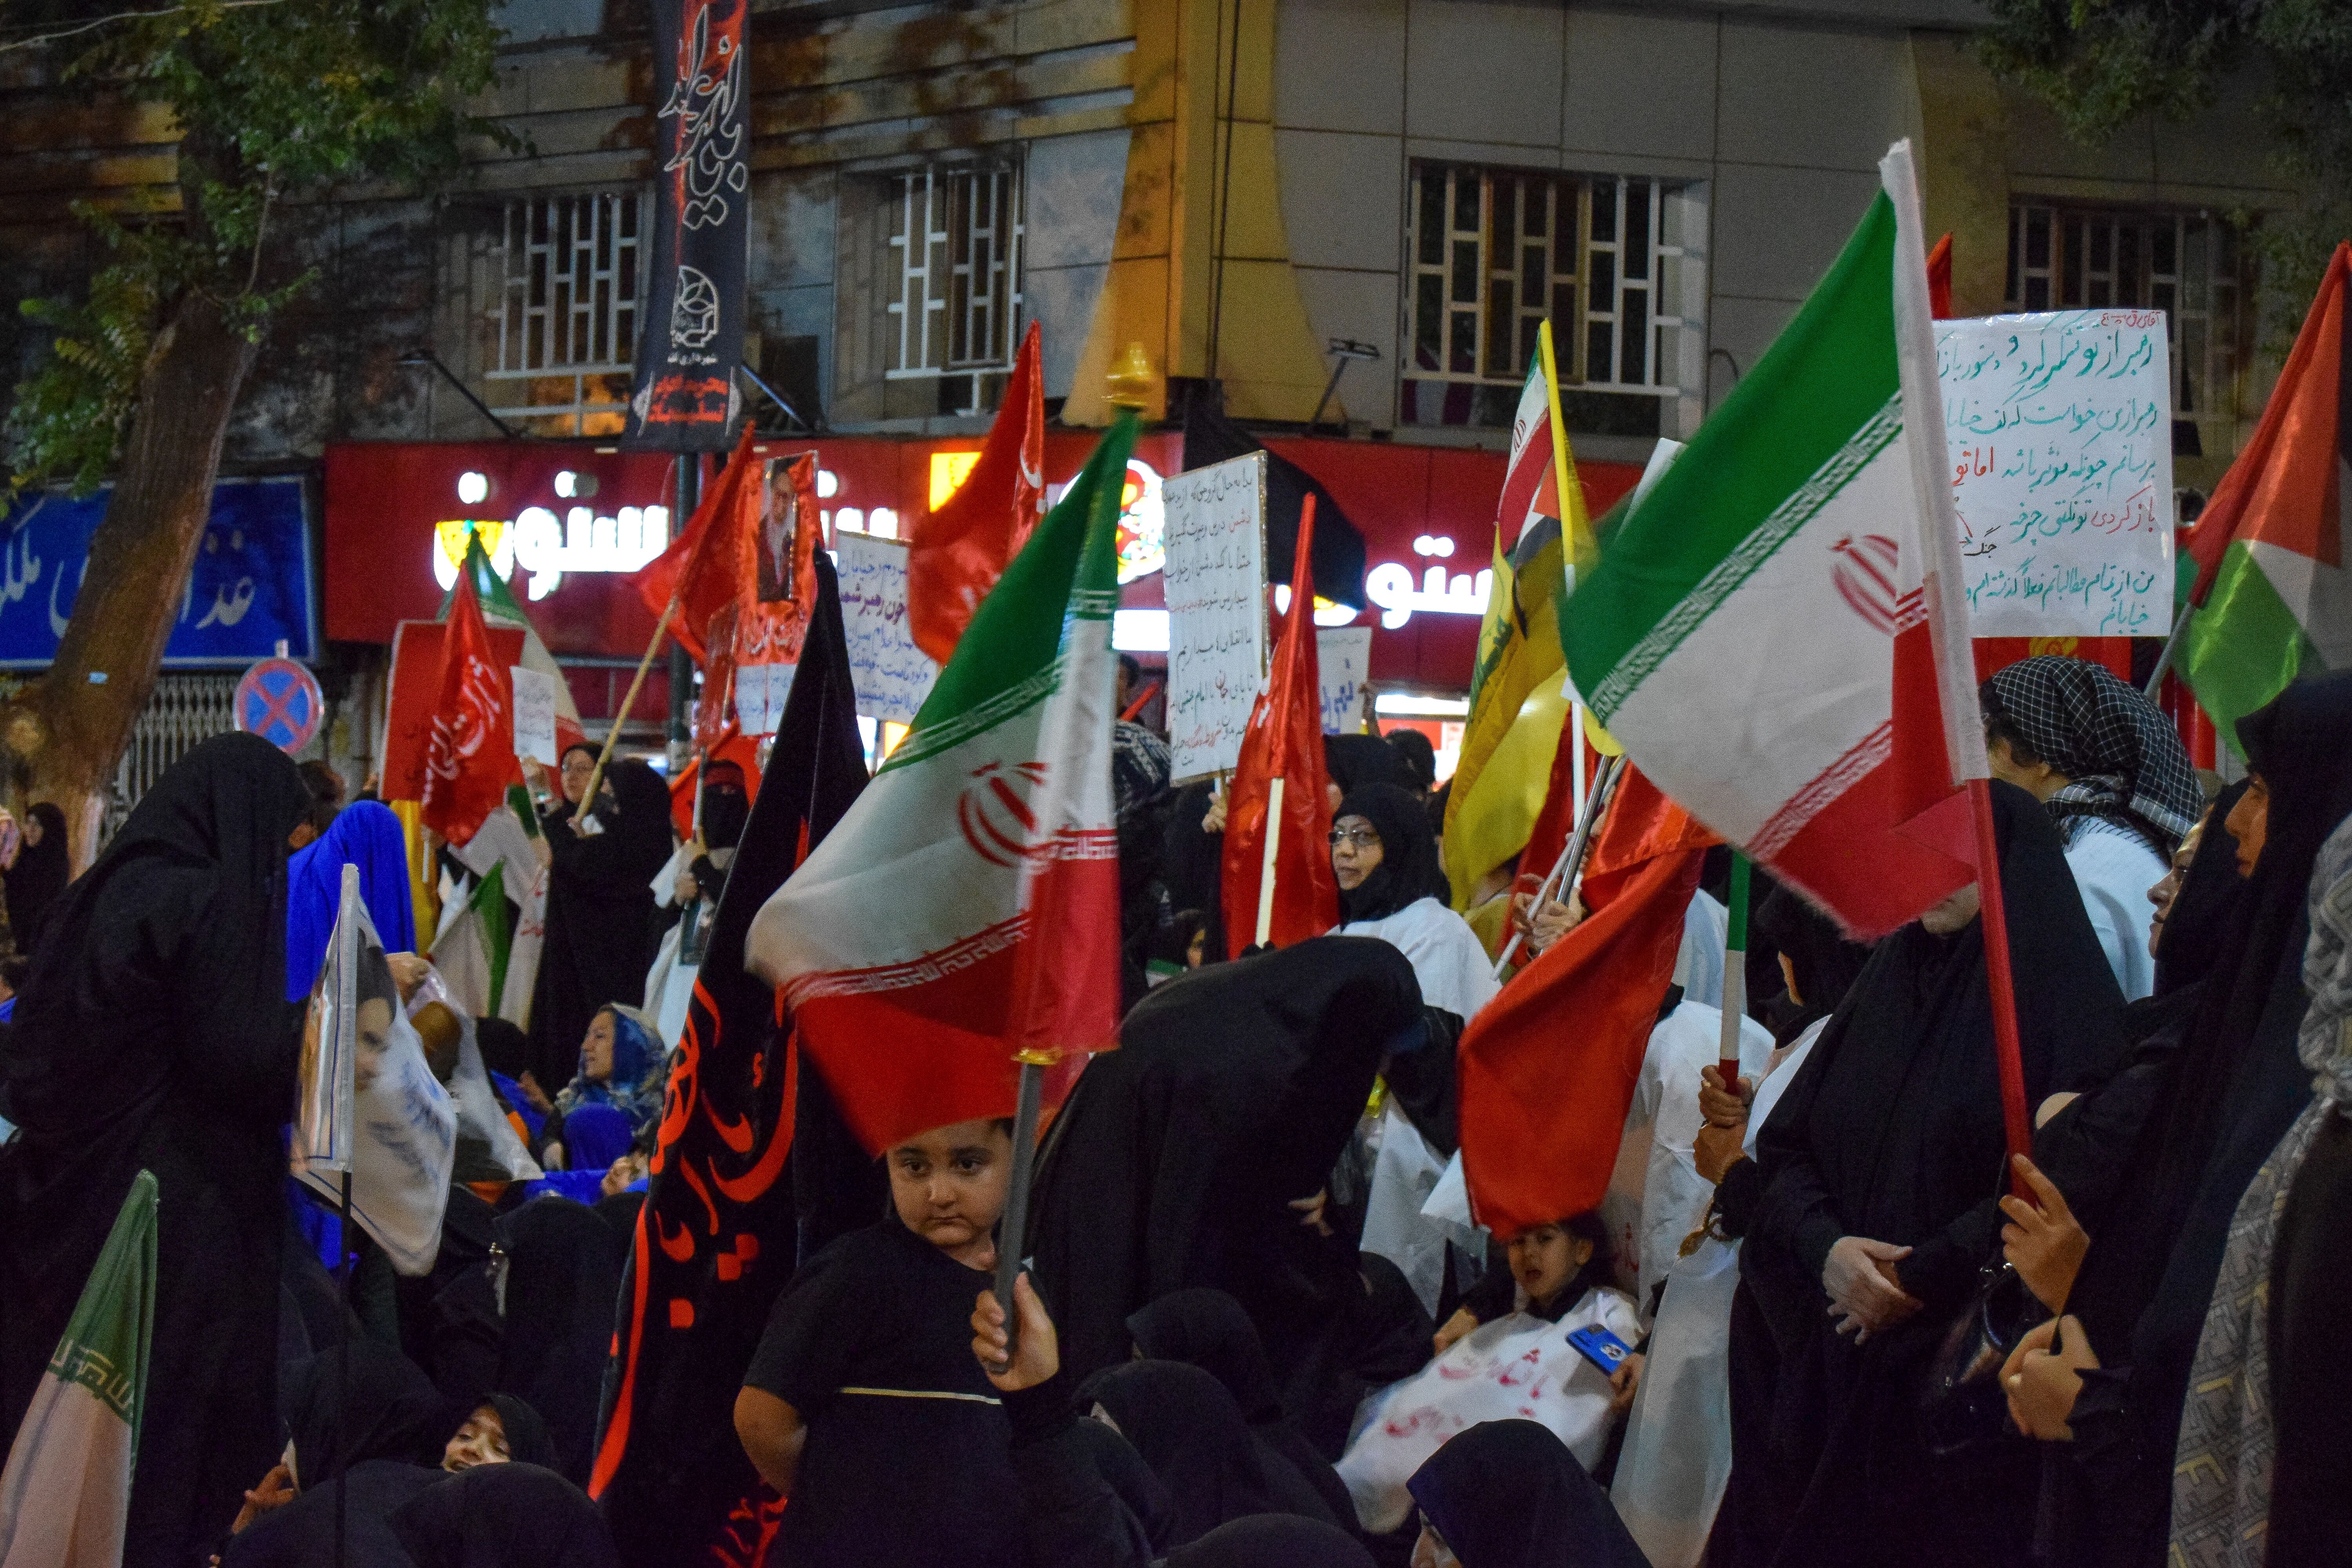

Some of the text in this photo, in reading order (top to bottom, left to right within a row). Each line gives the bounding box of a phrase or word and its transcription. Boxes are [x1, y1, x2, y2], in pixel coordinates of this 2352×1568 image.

[2006, 334, 2019, 358] و
[2075, 323, 2100, 377] تو
[2094, 328, 2119, 377] از
[2107, 334, 2152, 380] رهبر
[1947, 397, 1982, 446] خیابا
[2118, 397, 2136, 432] از
[2125, 401, 2159, 438] رهبر
[1973, 446, 1994, 477] اما
[2110, 570, 2130, 599] از
